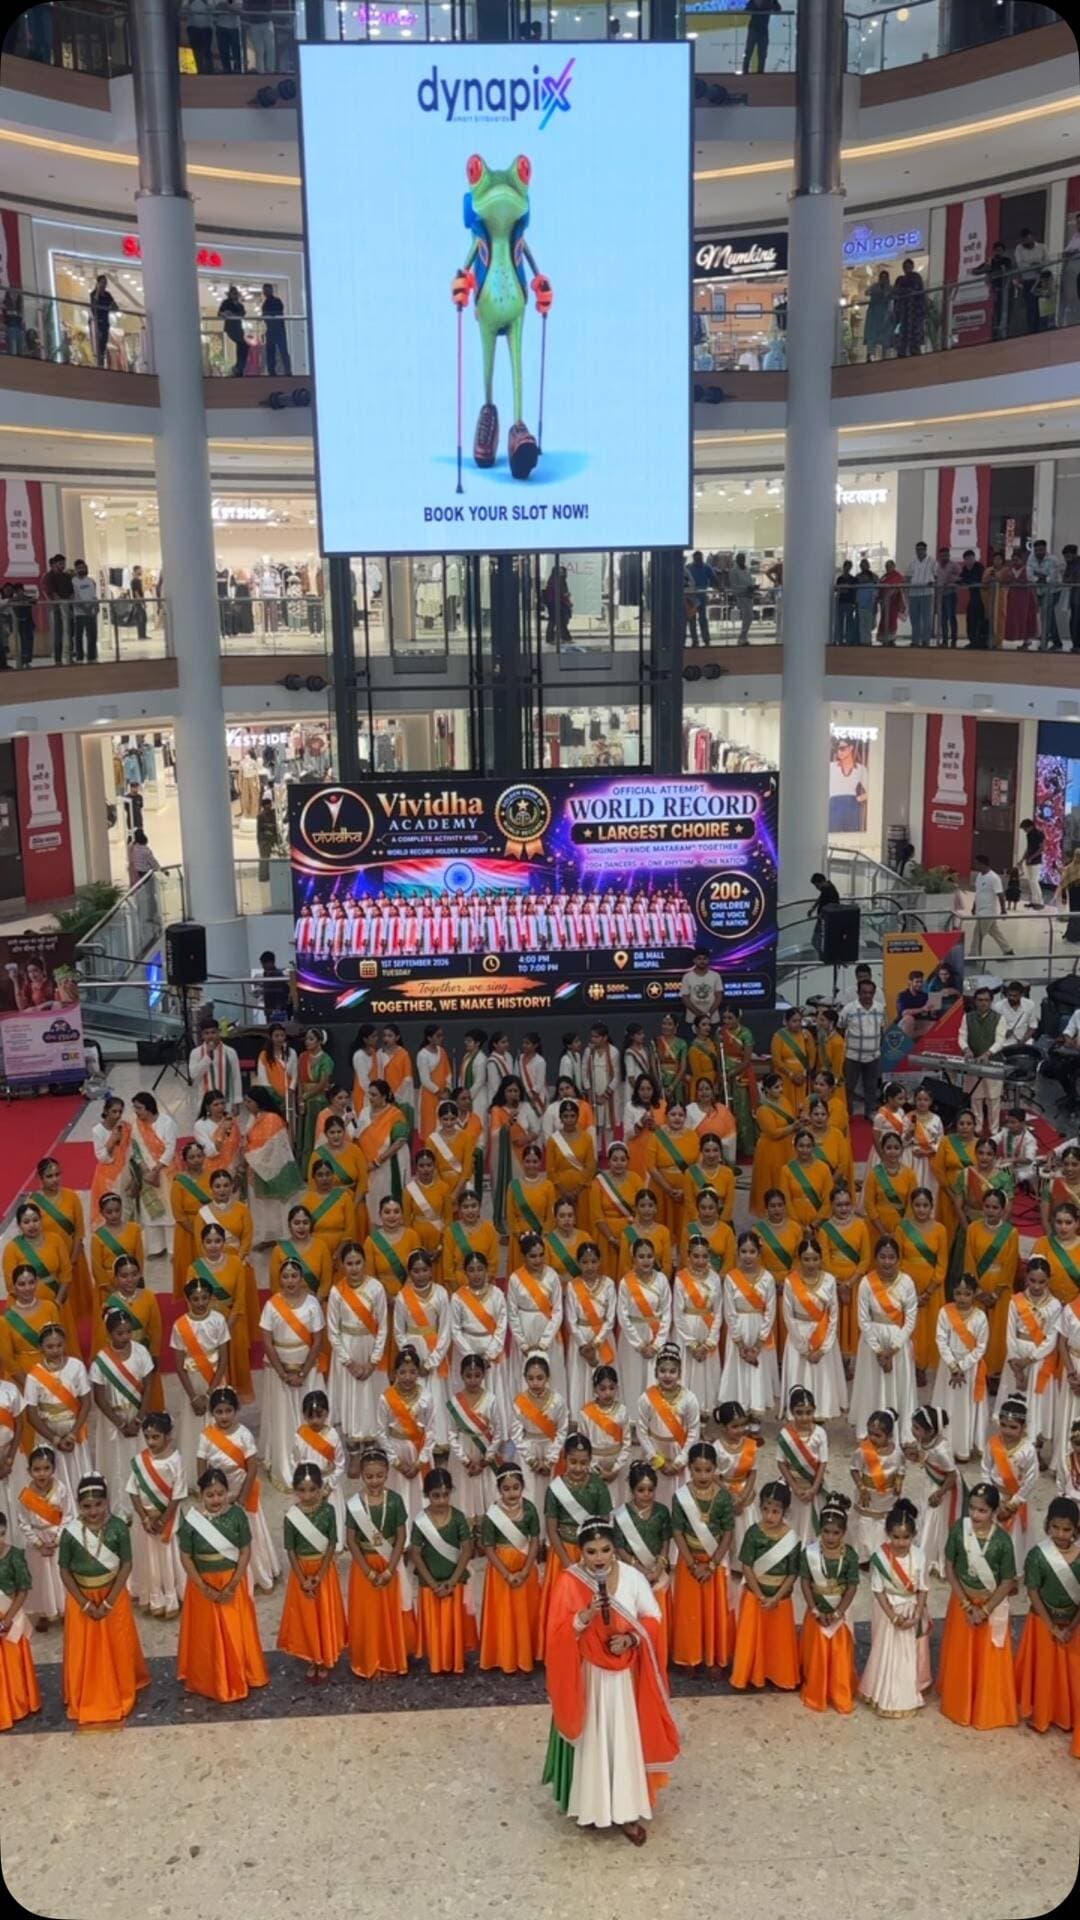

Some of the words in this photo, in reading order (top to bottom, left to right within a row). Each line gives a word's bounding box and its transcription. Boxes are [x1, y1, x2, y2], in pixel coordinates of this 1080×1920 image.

[418, 57, 575, 130] dynapix
[874, 230, 918, 250] ROSE
[696, 244, 777, 270] Mumkins
[424, 507, 464, 522] BOOK
[469, 506, 508, 521] YOUR
[512, 505, 547, 520] SLOT
[553, 504, 589, 519] NOW!
[612, 786, 656, 796] OFFICIAL
[660, 785, 704, 794] ATTEMPT
[376, 791, 484, 818] Vividha
[570, 798, 654, 820] WORLD
[664, 794, 758, 817] RECORD
[389, 818, 478, 830] ACADEMY
[598, 824, 668, 840] LARGEST
[672, 822, 730, 838] CHOIRE
[710, 882, 750, 900] 200+
[710, 901, 750, 910] CHILDREN
[393, 958, 432, 967] SEPTEMBER
[519, 955, 536, 963] 4:00
[646, 952, 665, 960] MALL
[518, 964, 528, 972] TO
[370, 1000, 437, 1013] TOGETHER,
[440, 999, 458, 1010] WE
[460, 998, 494, 1010] MAKE
[498, 996, 551, 1009] HISTORY!
